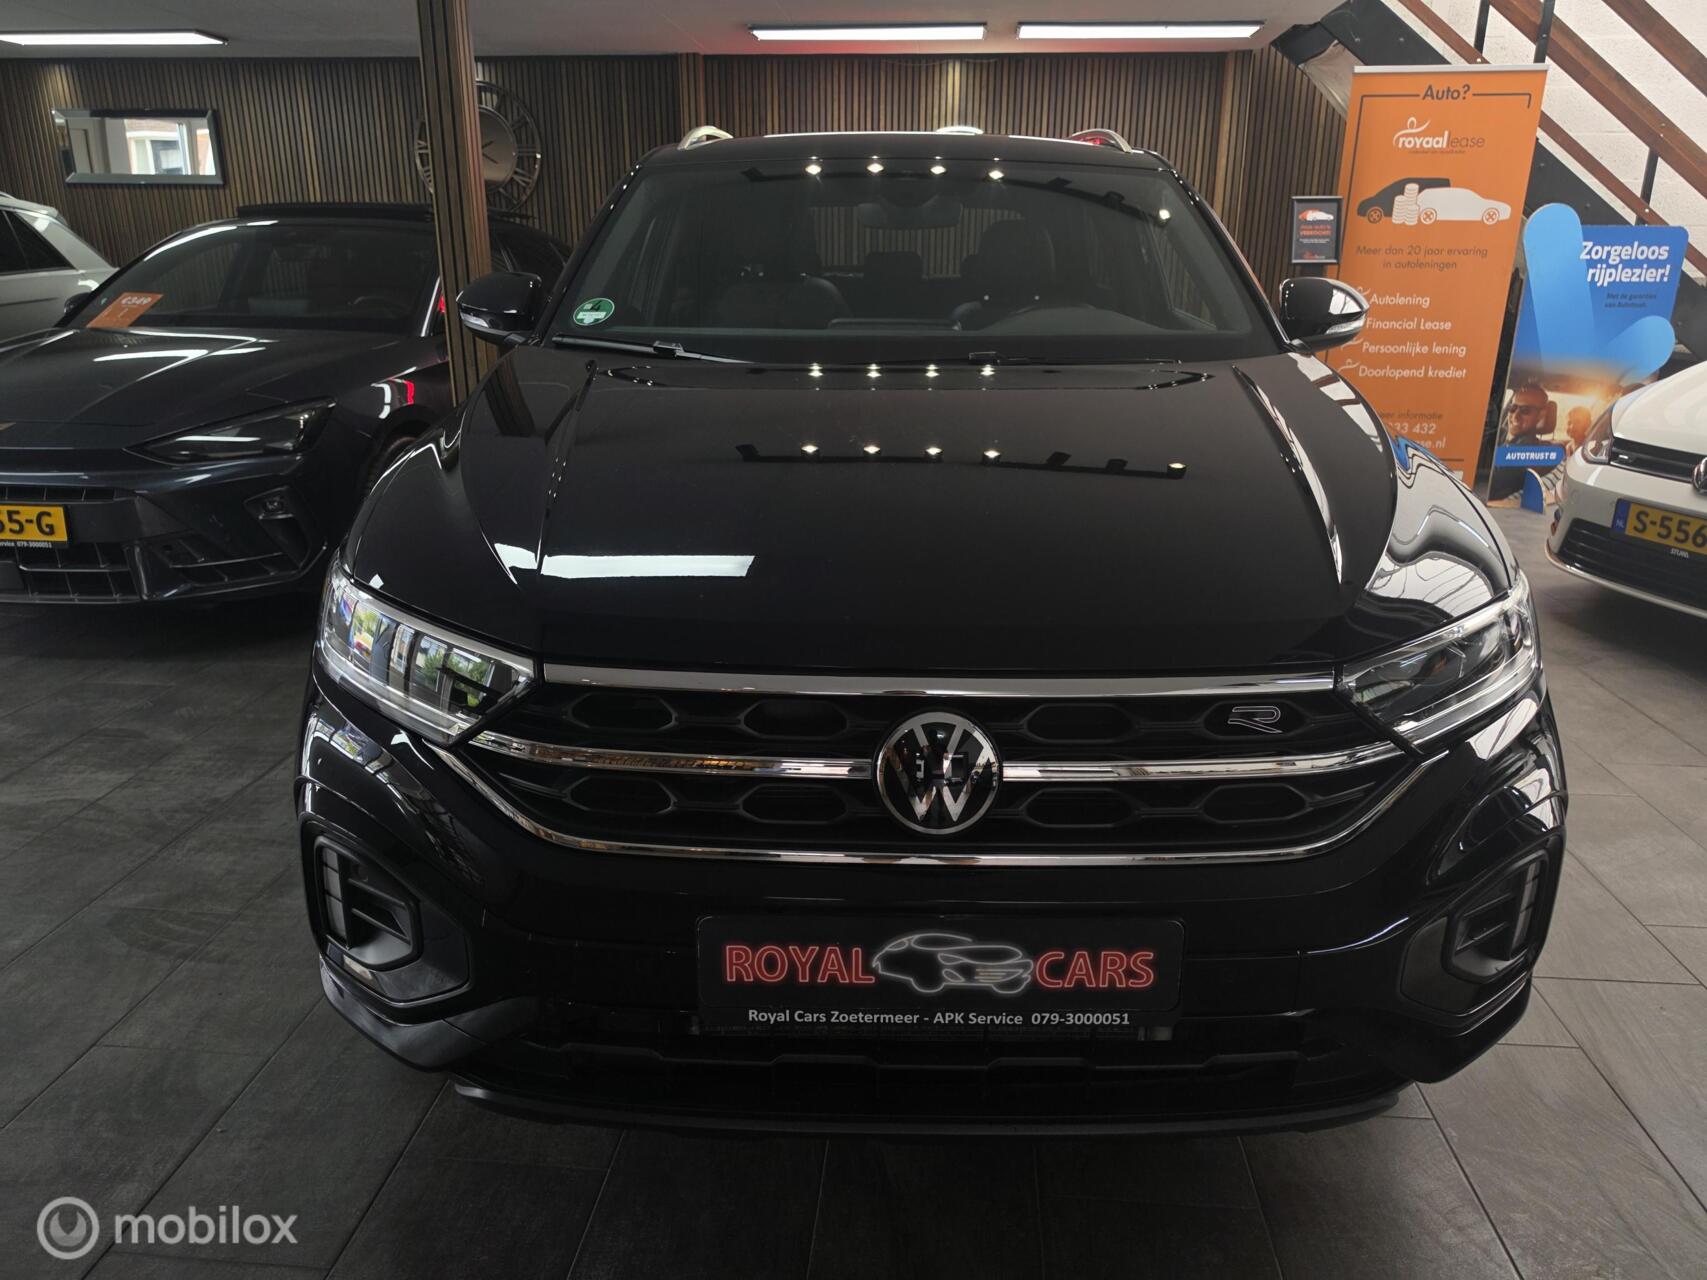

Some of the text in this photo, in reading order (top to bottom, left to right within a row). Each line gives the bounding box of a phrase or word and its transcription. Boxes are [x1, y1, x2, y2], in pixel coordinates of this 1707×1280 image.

[1422, 84, 1471, 100] Auto?
[1356, 245, 1488, 259] Meer dan 20 jaar ervaring
[1579, 241, 1670, 265] Zorgeloos
[1382, 259, 1457, 272] in autoleningen
[1586, 263, 1671, 287] rijplezier!
[1369, 293, 1431, 309] Autolening
[1366, 316, 1452, 331] Financial Lease
[1362, 341, 1468, 358] Persoonlijke lening
[1358, 364, 1467, 380] Doorlopend krediet
[1412, 422, 1437, 434] 432
[1505, 451, 1550, 461] AUTOTRUST
[724, 944, 1156, 989] ROYAL CARS
[748, 1009, 790, 1025] Royal
[794, 1010, 826, 1023] Cars
[830, 1010, 920, 1024] Zoetermeer
[933, 1012, 964, 1025] APK
[968, 1012, 1024, 1025] Service
[1031, 1012, 1130, 1025] 079-3000051
